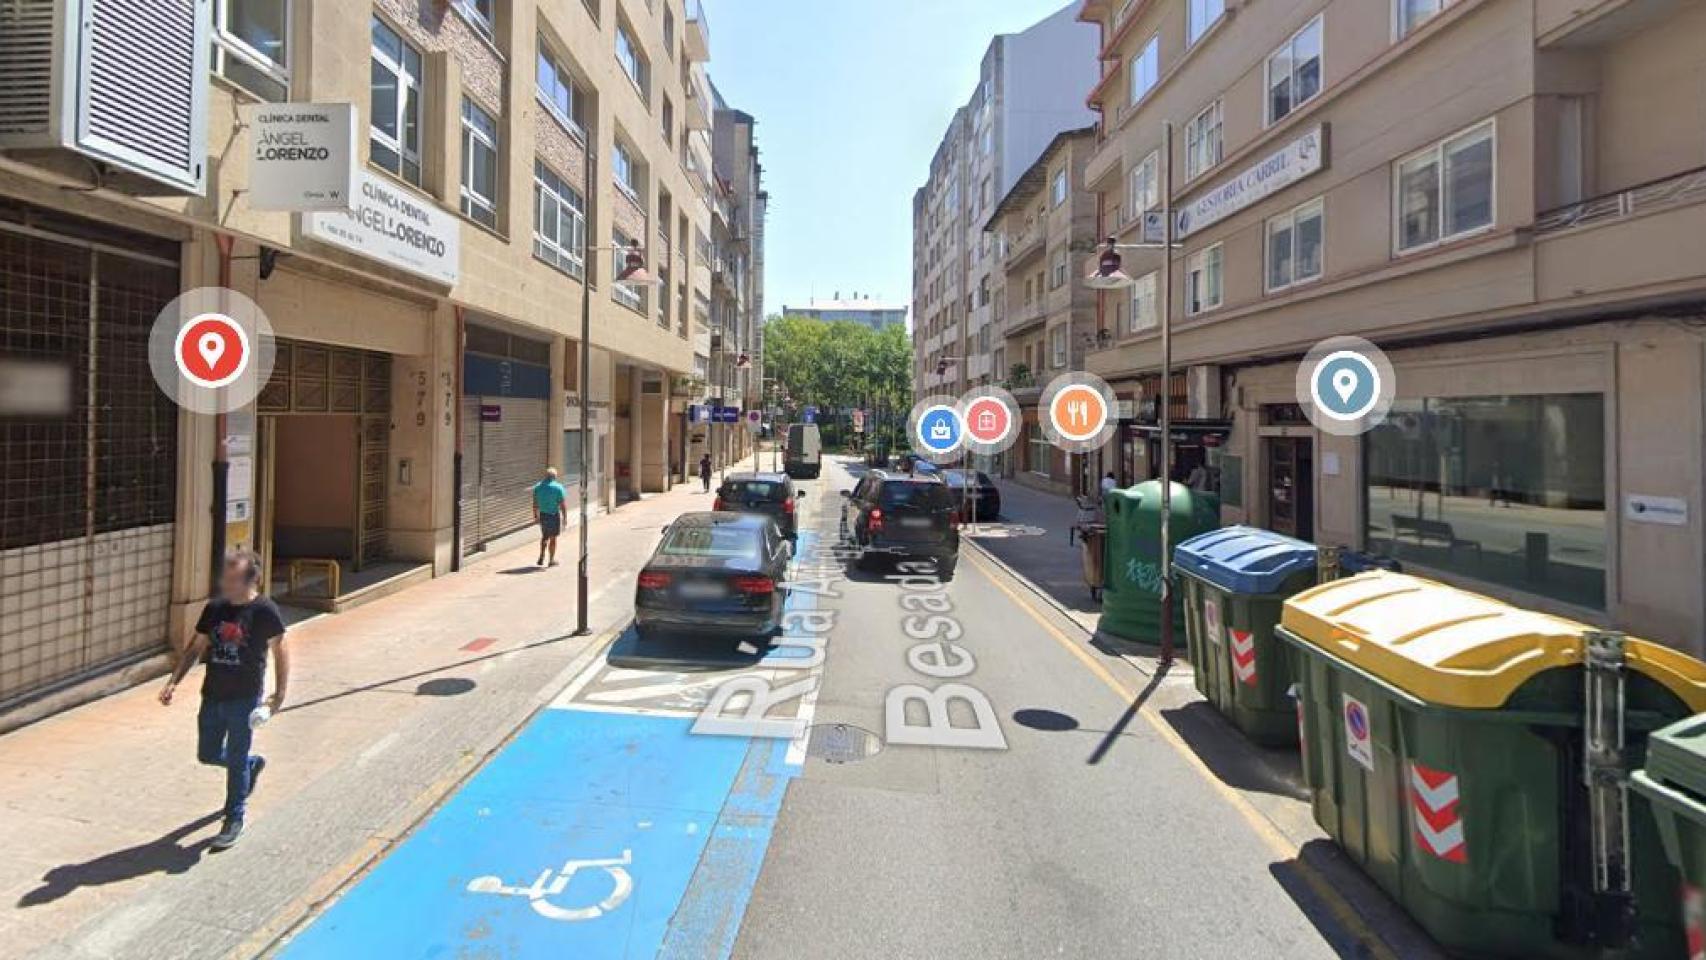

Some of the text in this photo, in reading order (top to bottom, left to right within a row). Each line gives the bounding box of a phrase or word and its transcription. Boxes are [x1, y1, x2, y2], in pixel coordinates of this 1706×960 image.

[295, 114, 330, 123] DENTAL
[256, 147, 329, 161] LORENZO
[388, 217, 446, 257] LORENZO
